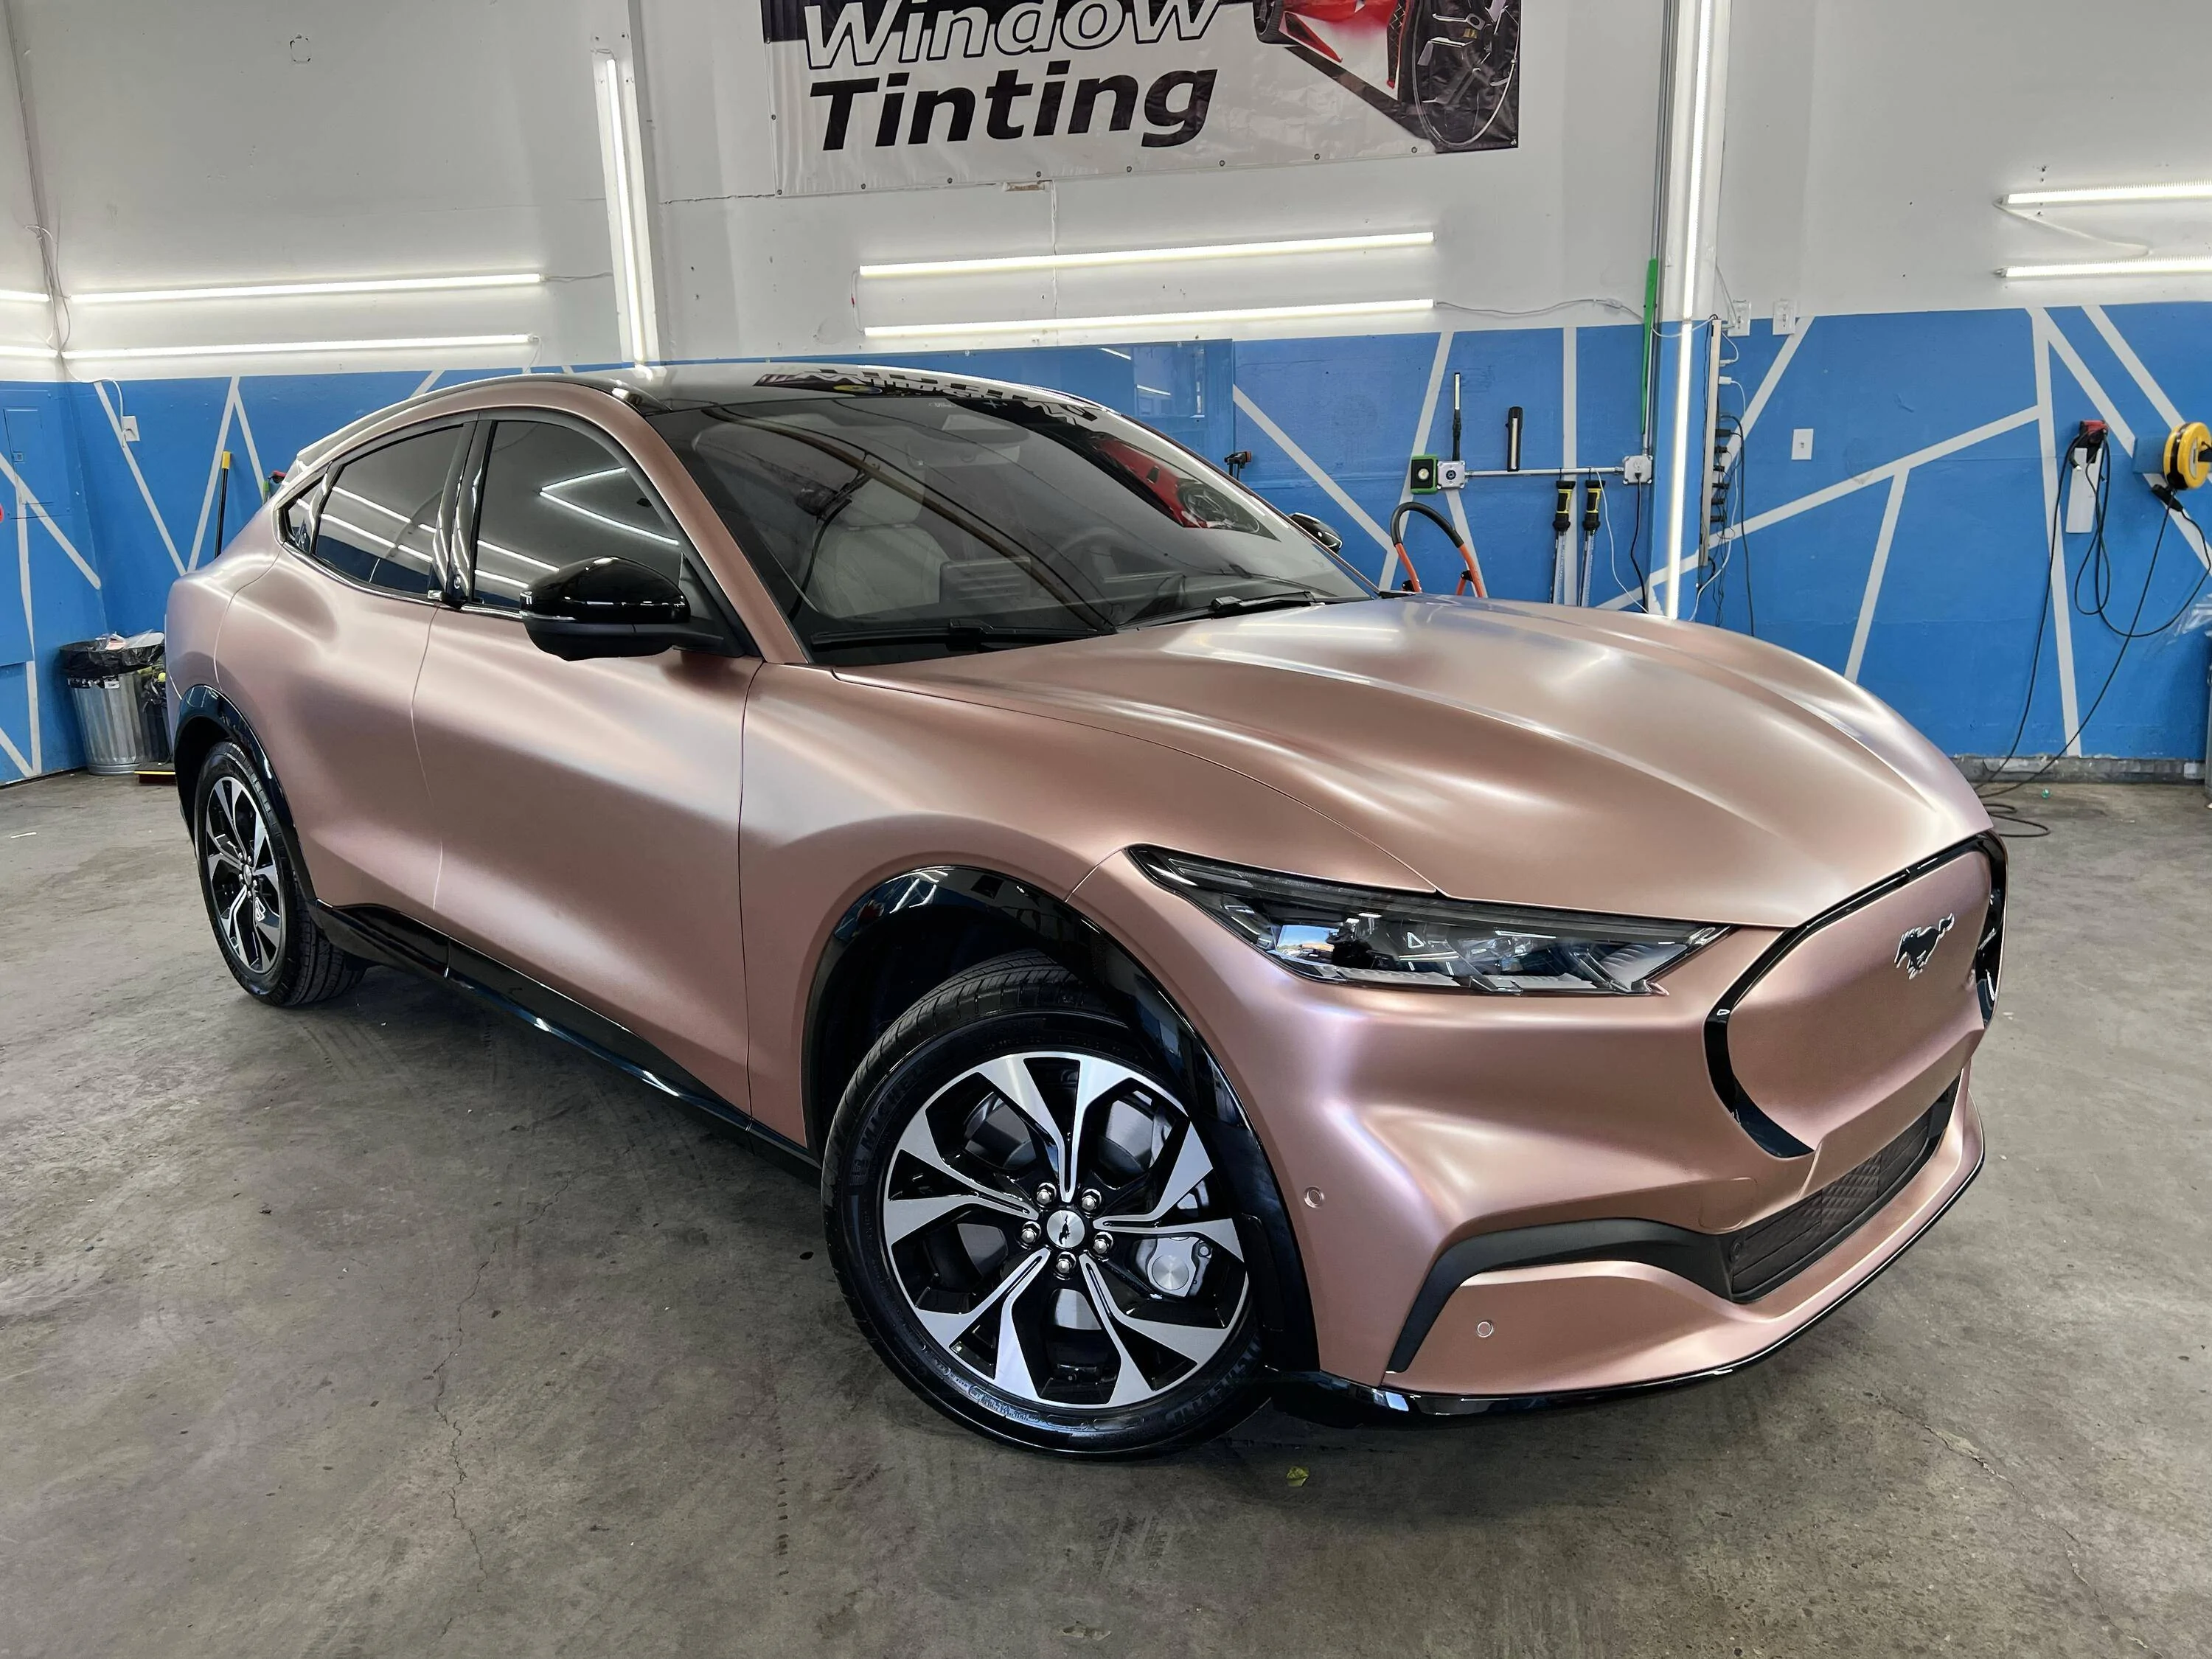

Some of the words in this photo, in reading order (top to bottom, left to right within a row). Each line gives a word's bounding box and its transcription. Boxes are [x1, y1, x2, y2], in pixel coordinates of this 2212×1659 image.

[804, 0, 1222, 69] Window
[810, 60, 1218, 150] Tinting
[860, 1059, 931, 1150] MICHEL
